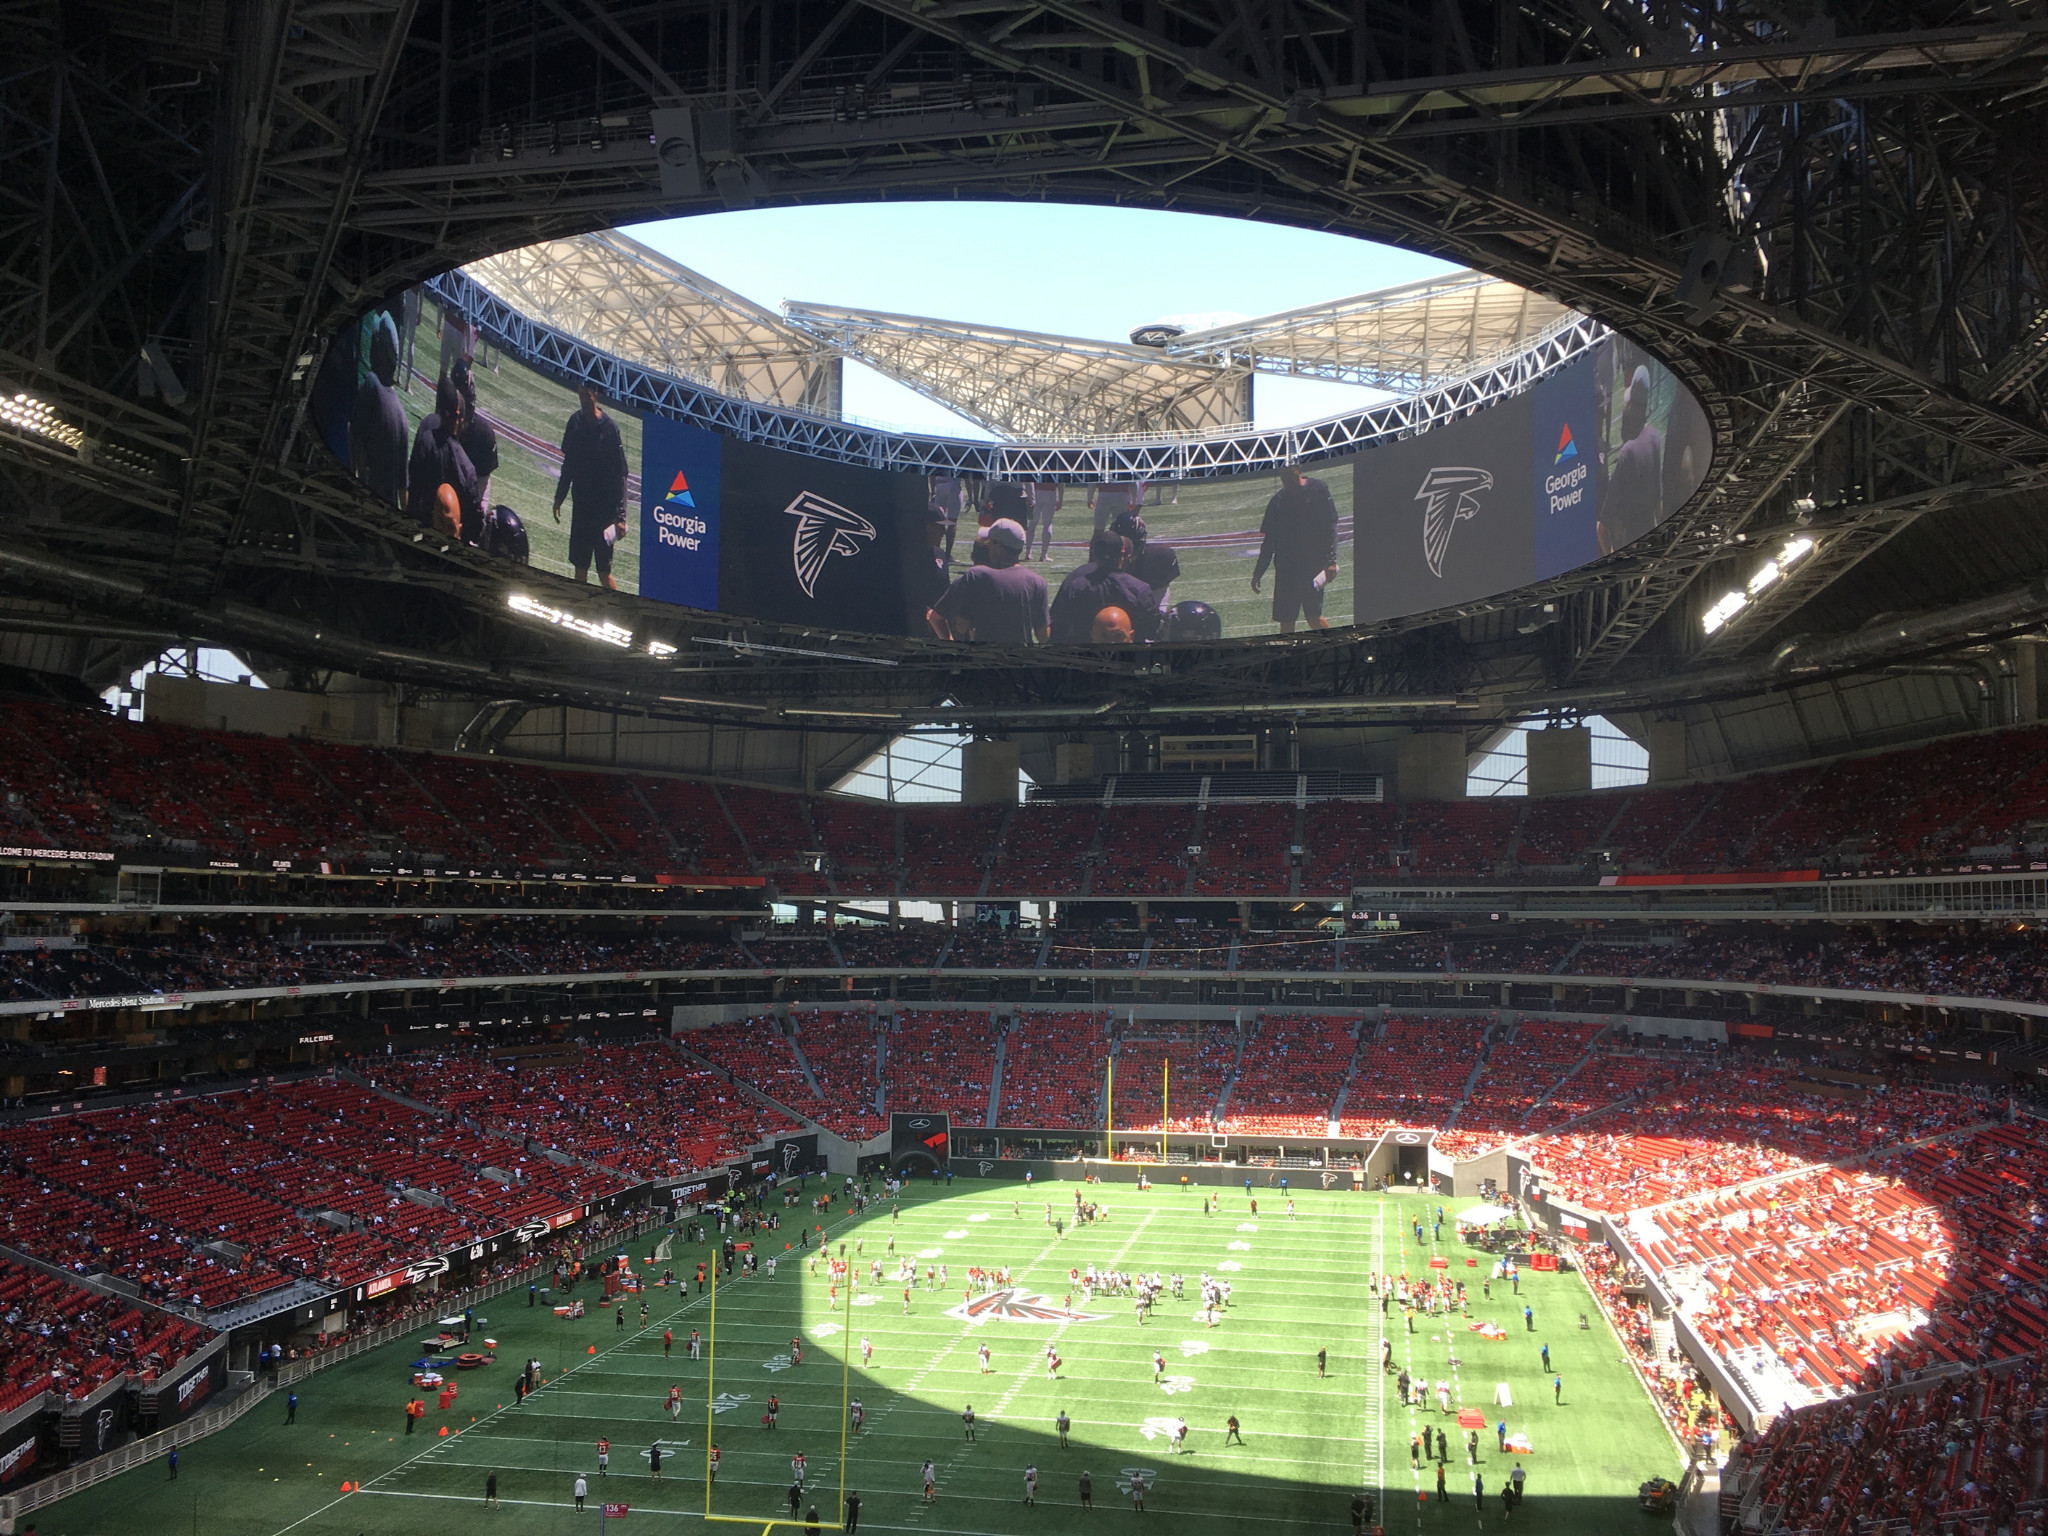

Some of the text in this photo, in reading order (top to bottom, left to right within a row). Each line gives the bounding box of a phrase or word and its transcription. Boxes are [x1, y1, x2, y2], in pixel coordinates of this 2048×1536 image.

[1545, 462, 1587, 494] Georgia
[1550, 487, 1583, 514] Power
[653, 505, 706, 534] Georgia
[659, 526, 701, 551] Power
[23, 848, 32, 857] TO
[33, 849, 87, 860] MERCEDES-BENZ
[87, 852, 114, 861] STADIUM
[1351, 911, 1369, 920] 6:36
[88, 998, 138, 1009] Mercedes-Benz
[138, 995, 165, 1006] Stadium
[299, 1034, 334, 1044] FALCONS
[671, 1182, 707, 1200] TOGETHER
[470, 1243, 484, 1260] 6:36
[356, 1286, 362, 1302] 0
[368, 1277, 392, 1295] ATLANTA
[606, 1504, 619, 1513] 136
